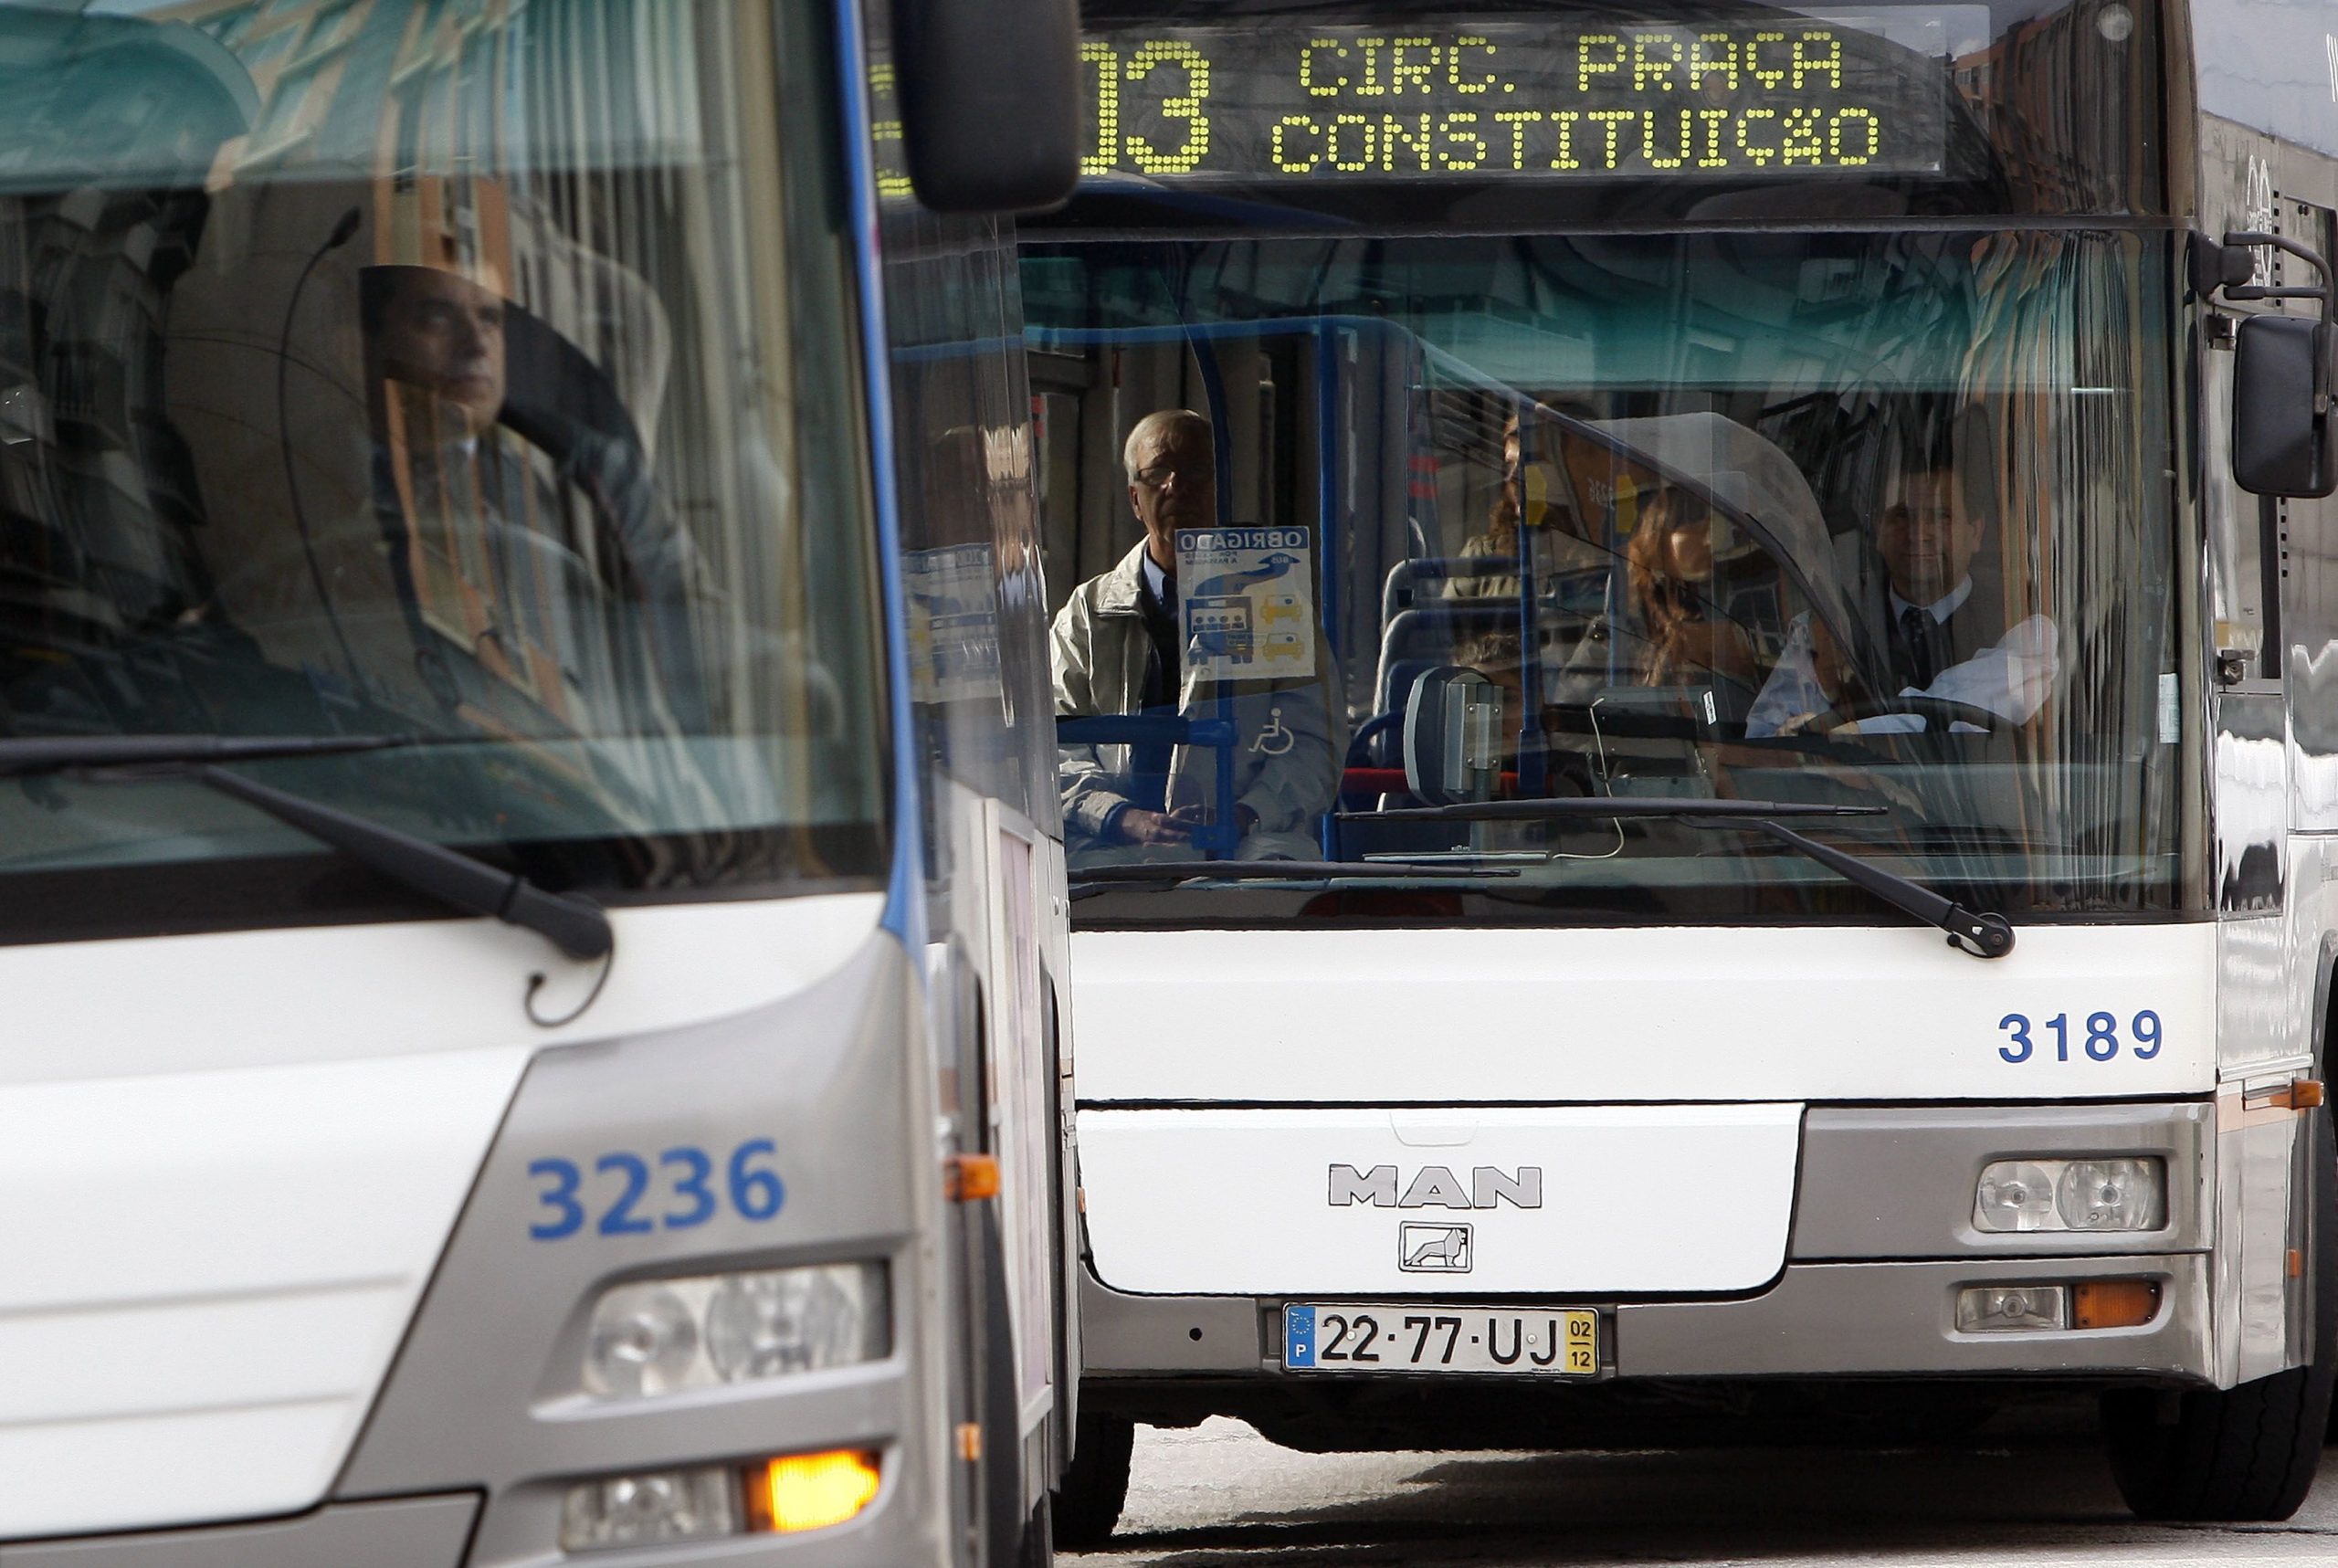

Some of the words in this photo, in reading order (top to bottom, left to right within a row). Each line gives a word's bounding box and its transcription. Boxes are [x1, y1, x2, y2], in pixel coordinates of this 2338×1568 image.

[1299, 37, 1516, 97] CIRC.
[1578, 32, 1841, 91] PRAÇA
[1998, 1009, 2163, 1064] 3189
[528, 1137, 787, 1242] 3236
[1328, 1163, 1543, 1210] MAN
[1295, 1343, 1307, 1358] P
[1570, 1320, 1591, 1338] 02
[1571, 1351, 1591, 1367] 12
